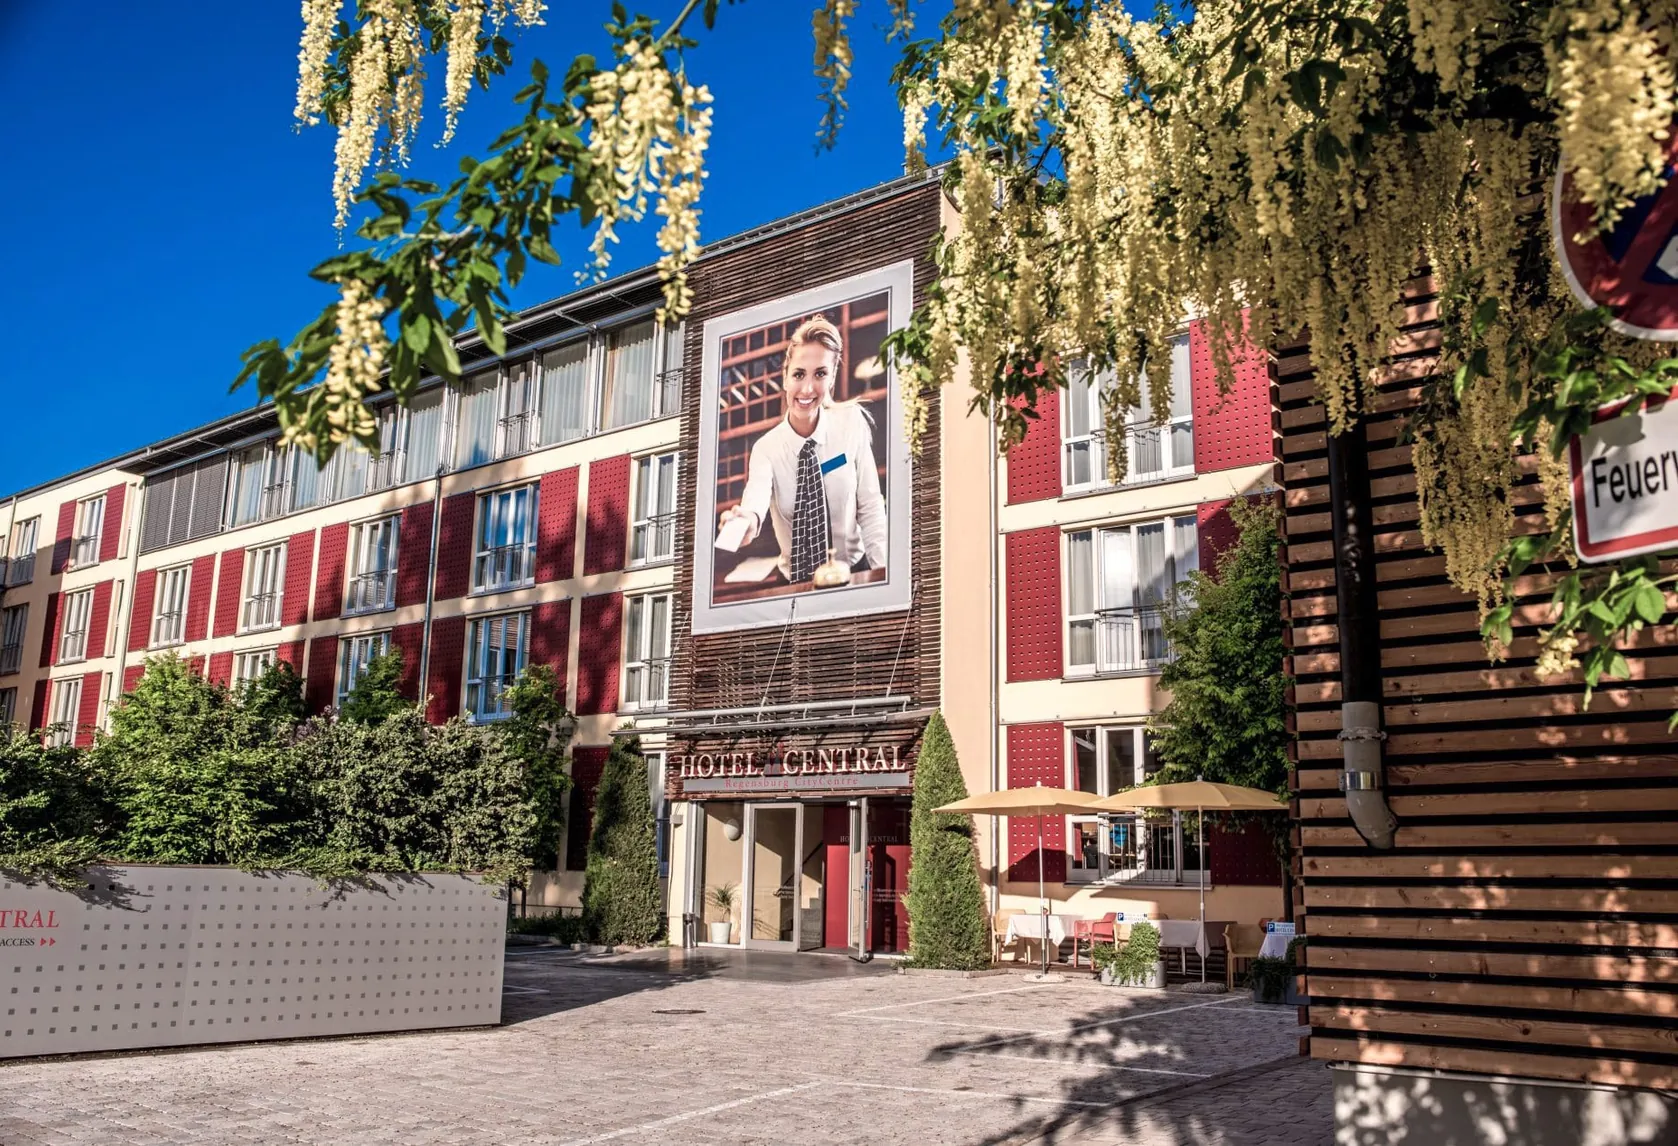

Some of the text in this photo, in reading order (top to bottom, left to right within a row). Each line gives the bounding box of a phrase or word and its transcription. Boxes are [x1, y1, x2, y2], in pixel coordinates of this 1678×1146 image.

[679, 745, 906, 777] HOTEL CENTRAL
[725, 778, 789, 789] Regensburg
[0, 937, 35, 947] ACCESS
